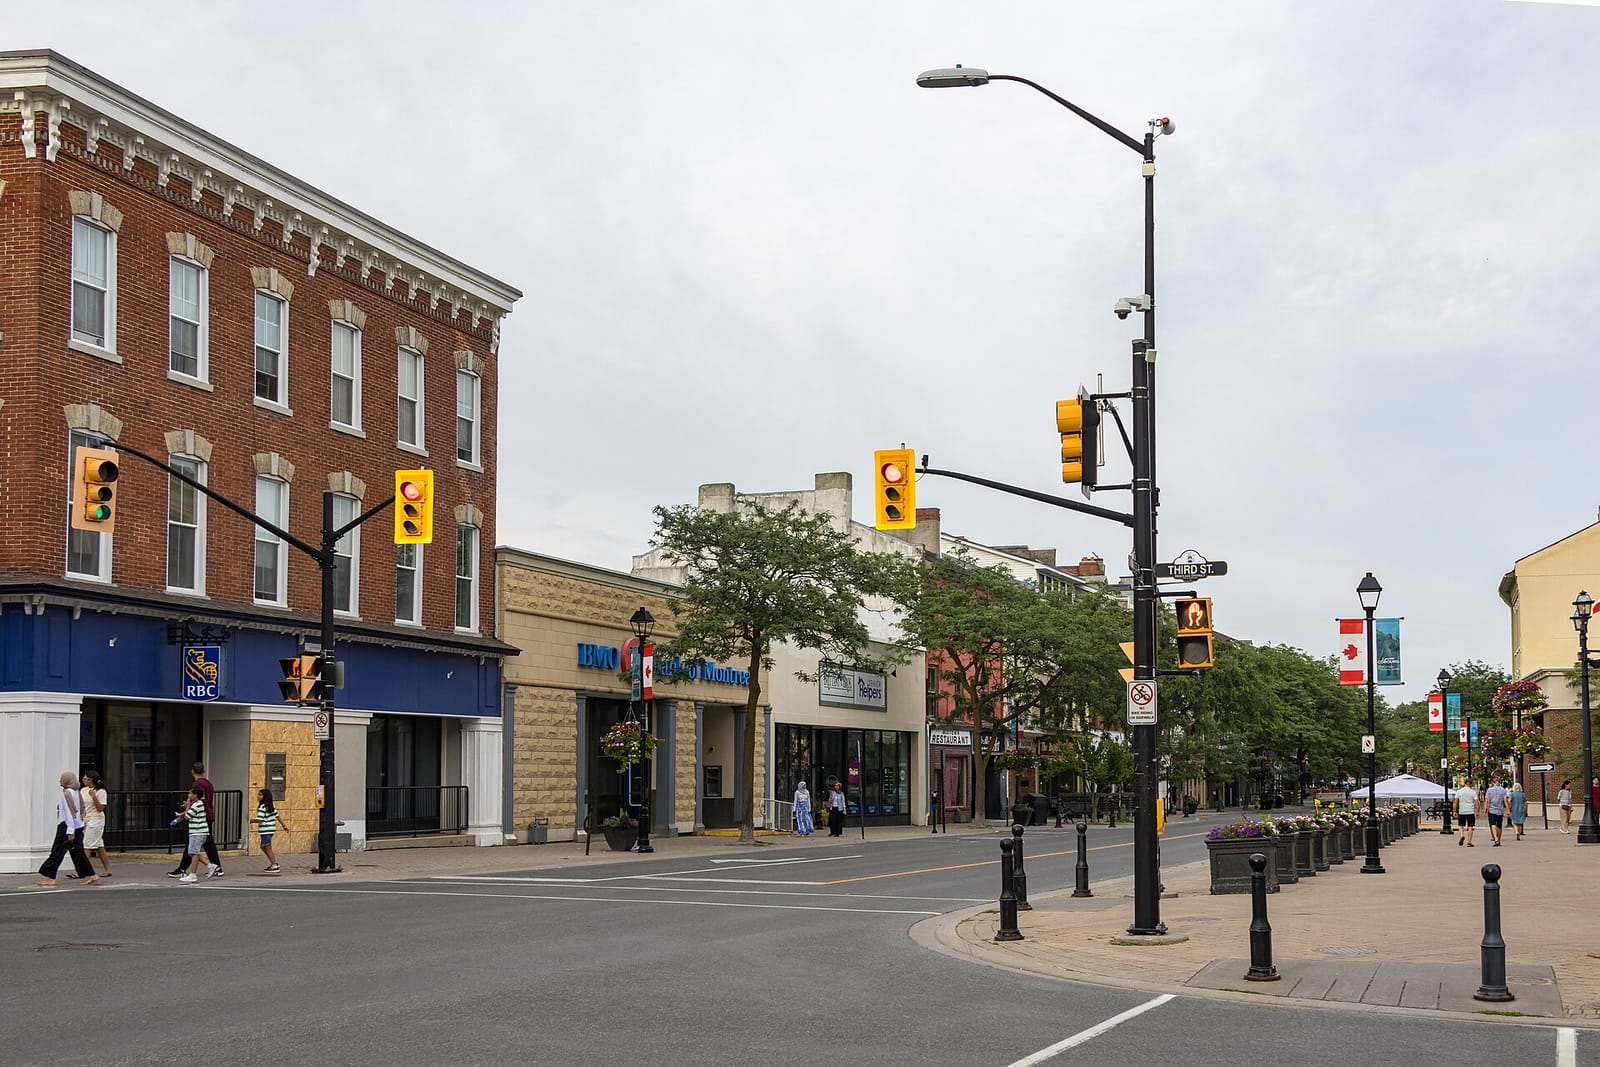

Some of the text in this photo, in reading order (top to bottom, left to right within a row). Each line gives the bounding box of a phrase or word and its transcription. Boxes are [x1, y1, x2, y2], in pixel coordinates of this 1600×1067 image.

[1167, 563, 1215, 575] THIRD ST.
[577, 643, 620, 669] BMO
[701, 661, 751, 687] Montrea
[186, 685, 216, 697] RBC
[858, 683, 882, 702] Helpers
[931, 733, 969, 746] RESTAURANT
